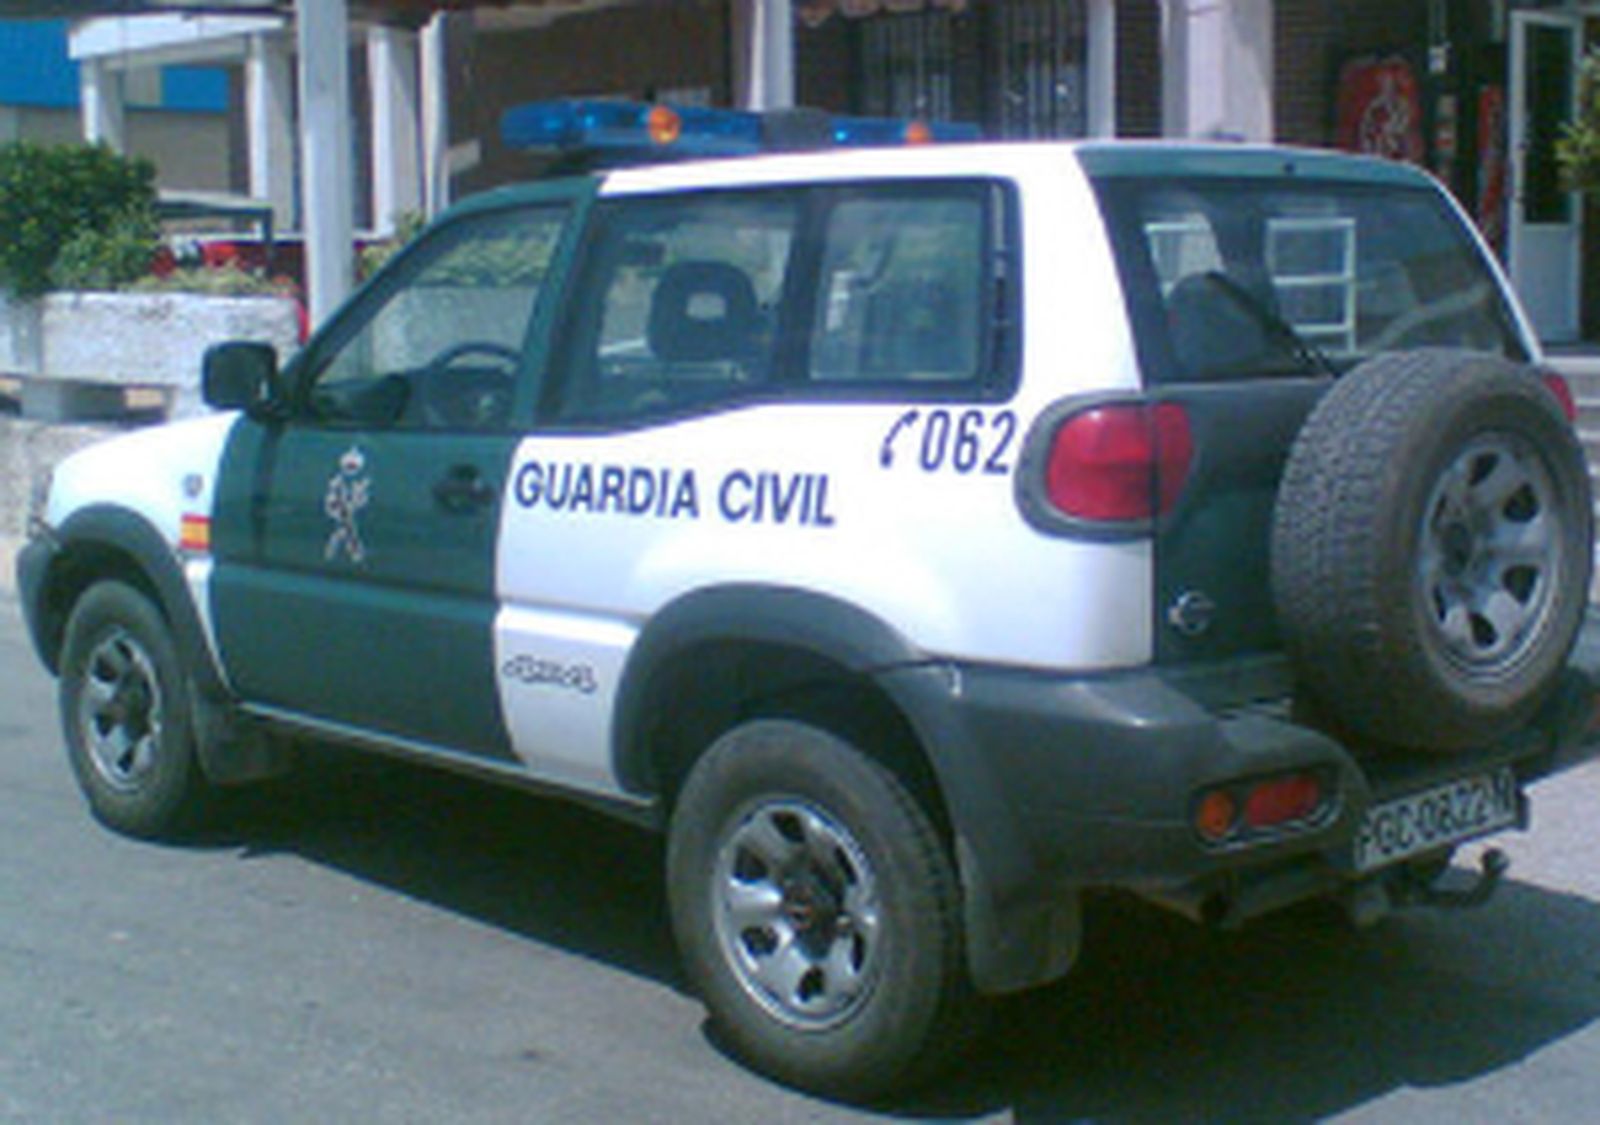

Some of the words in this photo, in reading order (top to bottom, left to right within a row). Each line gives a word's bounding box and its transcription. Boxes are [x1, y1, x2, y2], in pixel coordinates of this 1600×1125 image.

[920, 409, 1017, 475] 062
[514, 461, 700, 518] GUARDIA
[718, 470, 836, 526] CIVIL
